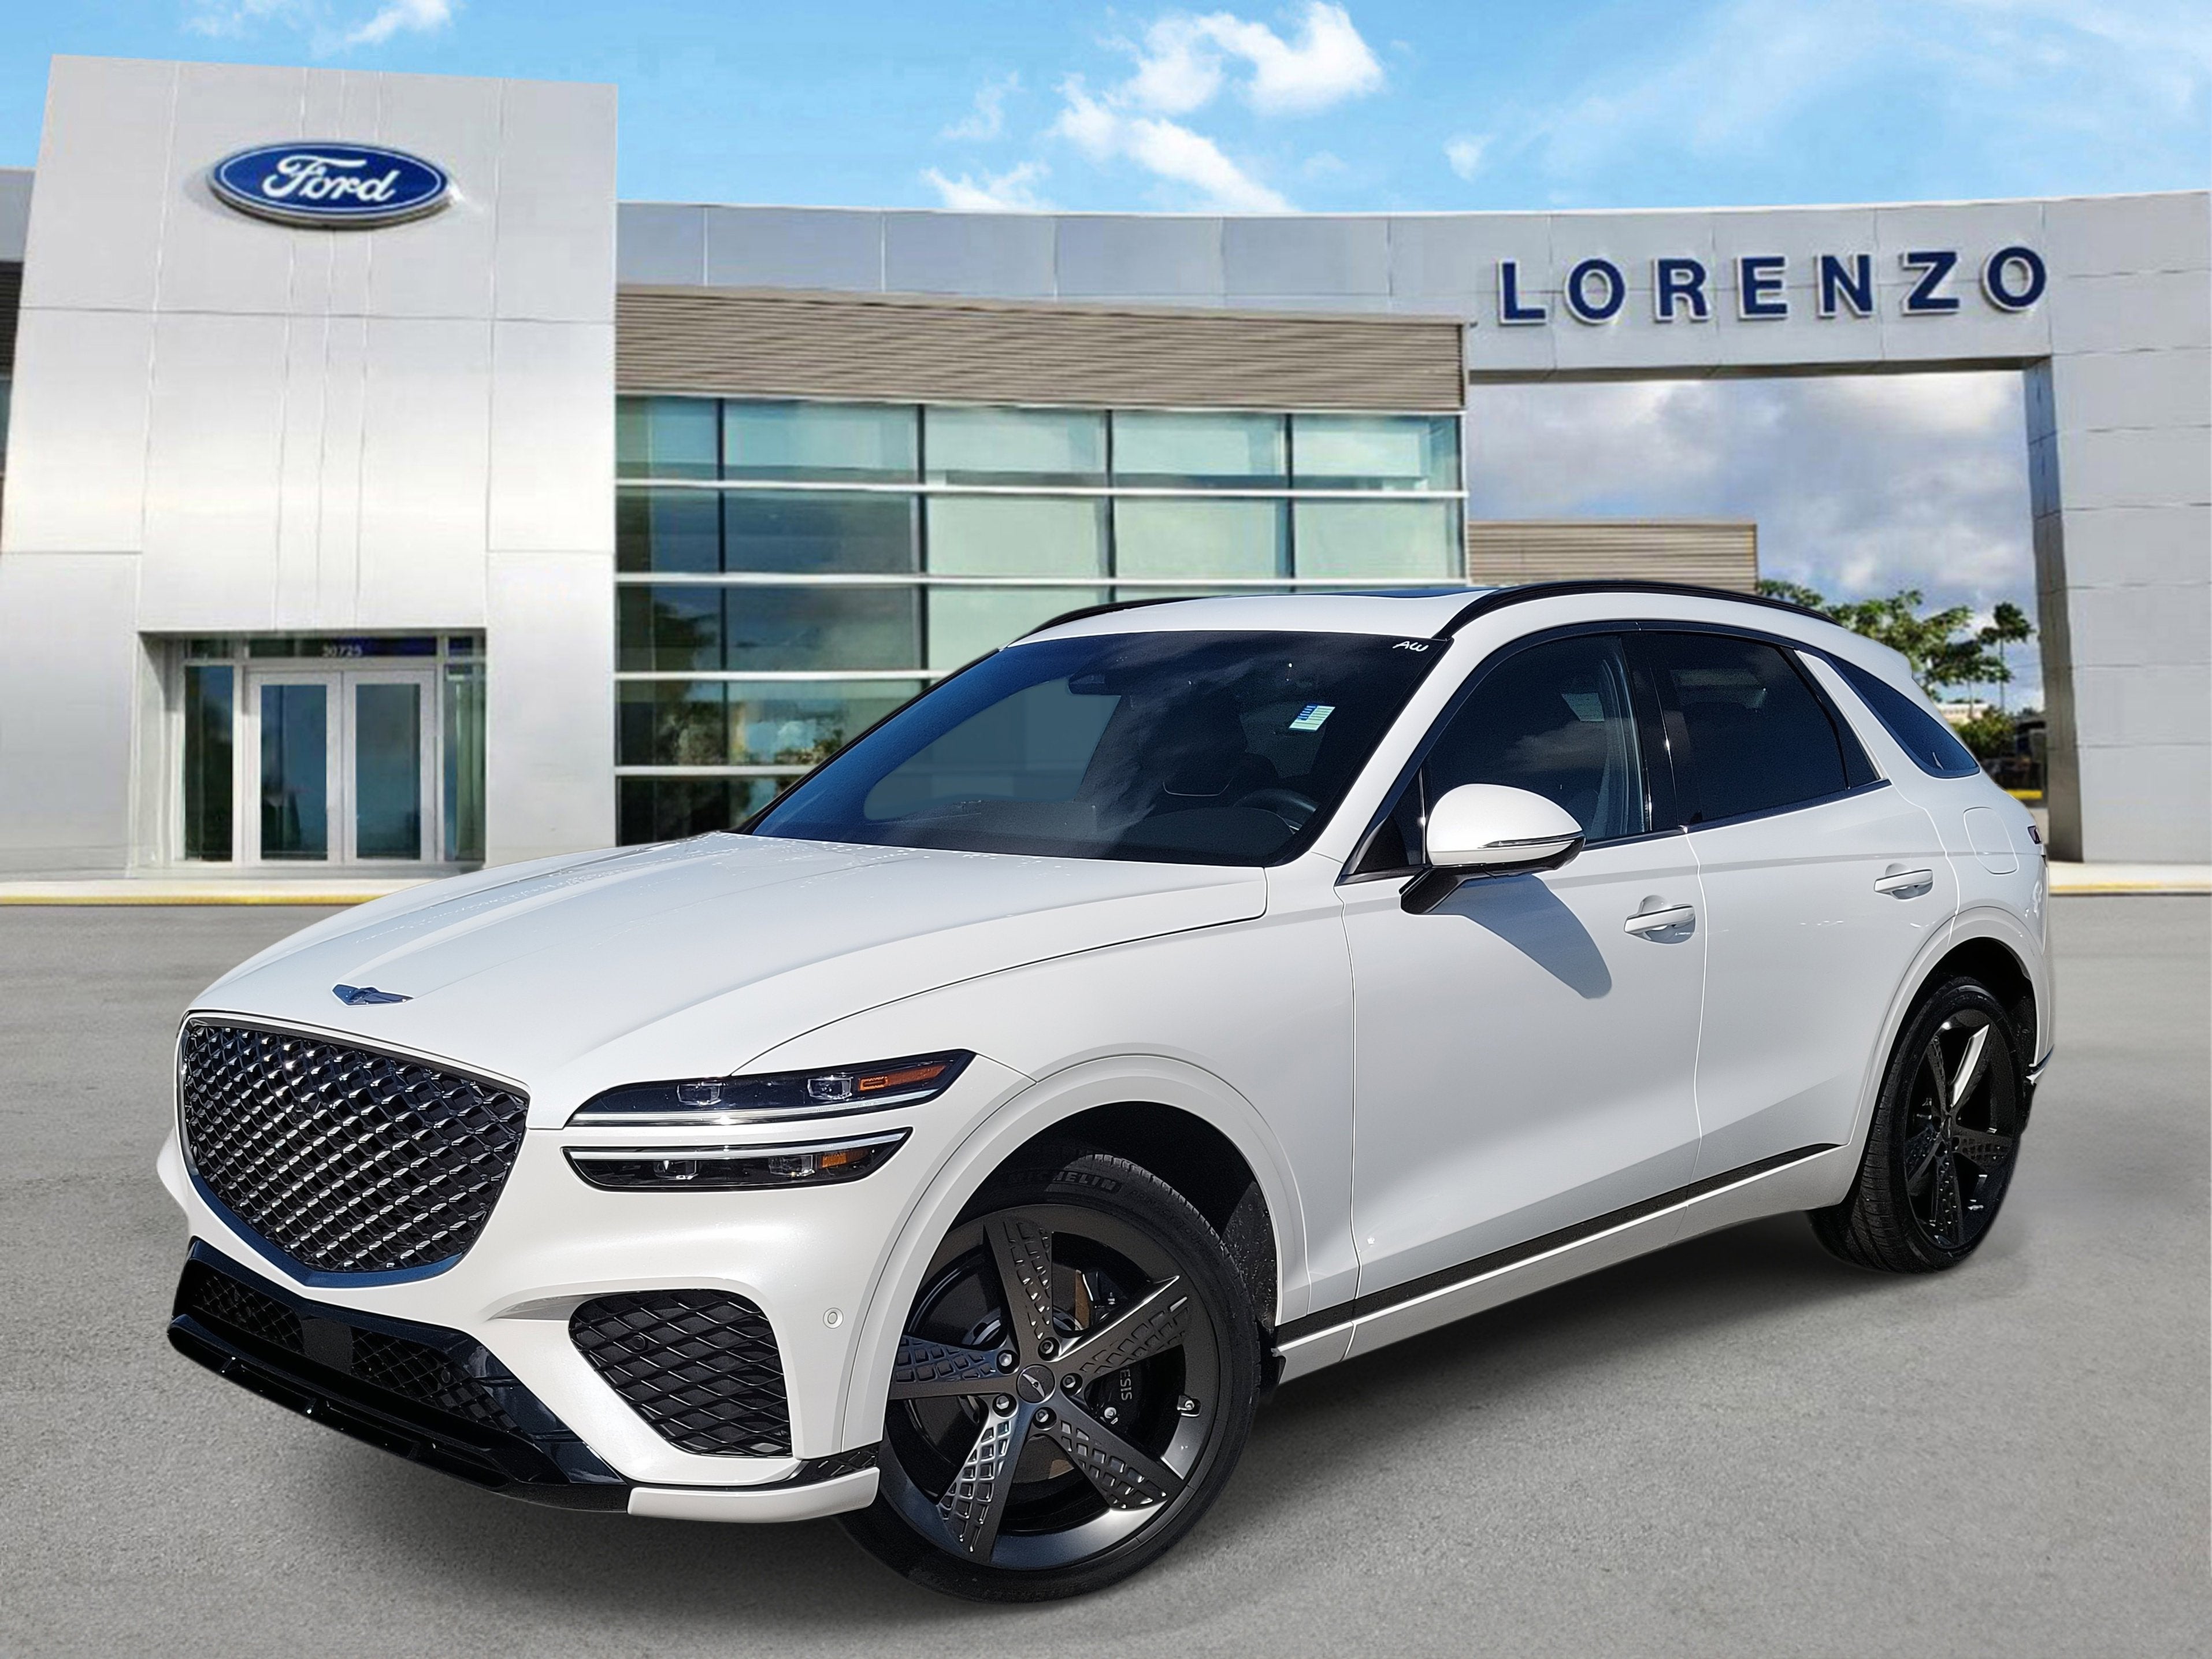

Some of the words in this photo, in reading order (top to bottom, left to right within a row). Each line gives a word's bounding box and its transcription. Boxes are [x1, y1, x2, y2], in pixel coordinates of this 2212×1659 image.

[262, 155, 400, 201] Ford
[1499, 245, 2047, 322] LORENZO
[1119, 1368, 1133, 1401] ESIS
